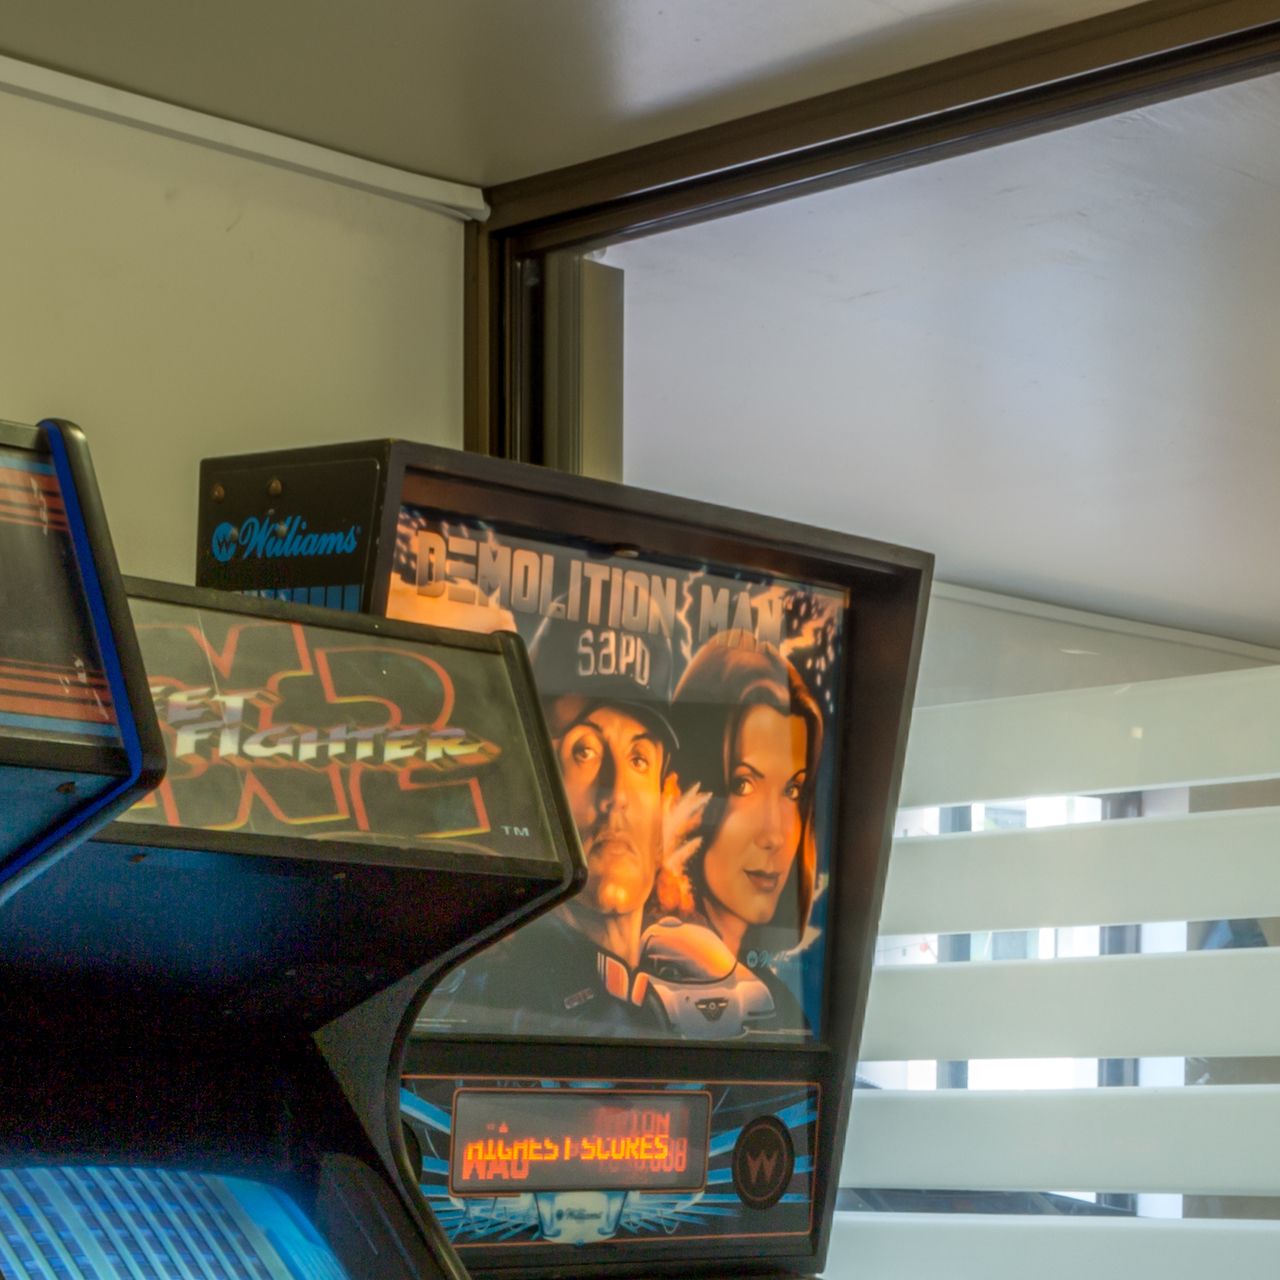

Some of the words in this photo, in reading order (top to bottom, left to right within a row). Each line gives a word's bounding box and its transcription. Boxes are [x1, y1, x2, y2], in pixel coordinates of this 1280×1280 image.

[415, 530, 677, 636] DEMOLITION
[699, 583, 784, 654] MAN
[175, 722, 498, 769] FIGHTER
